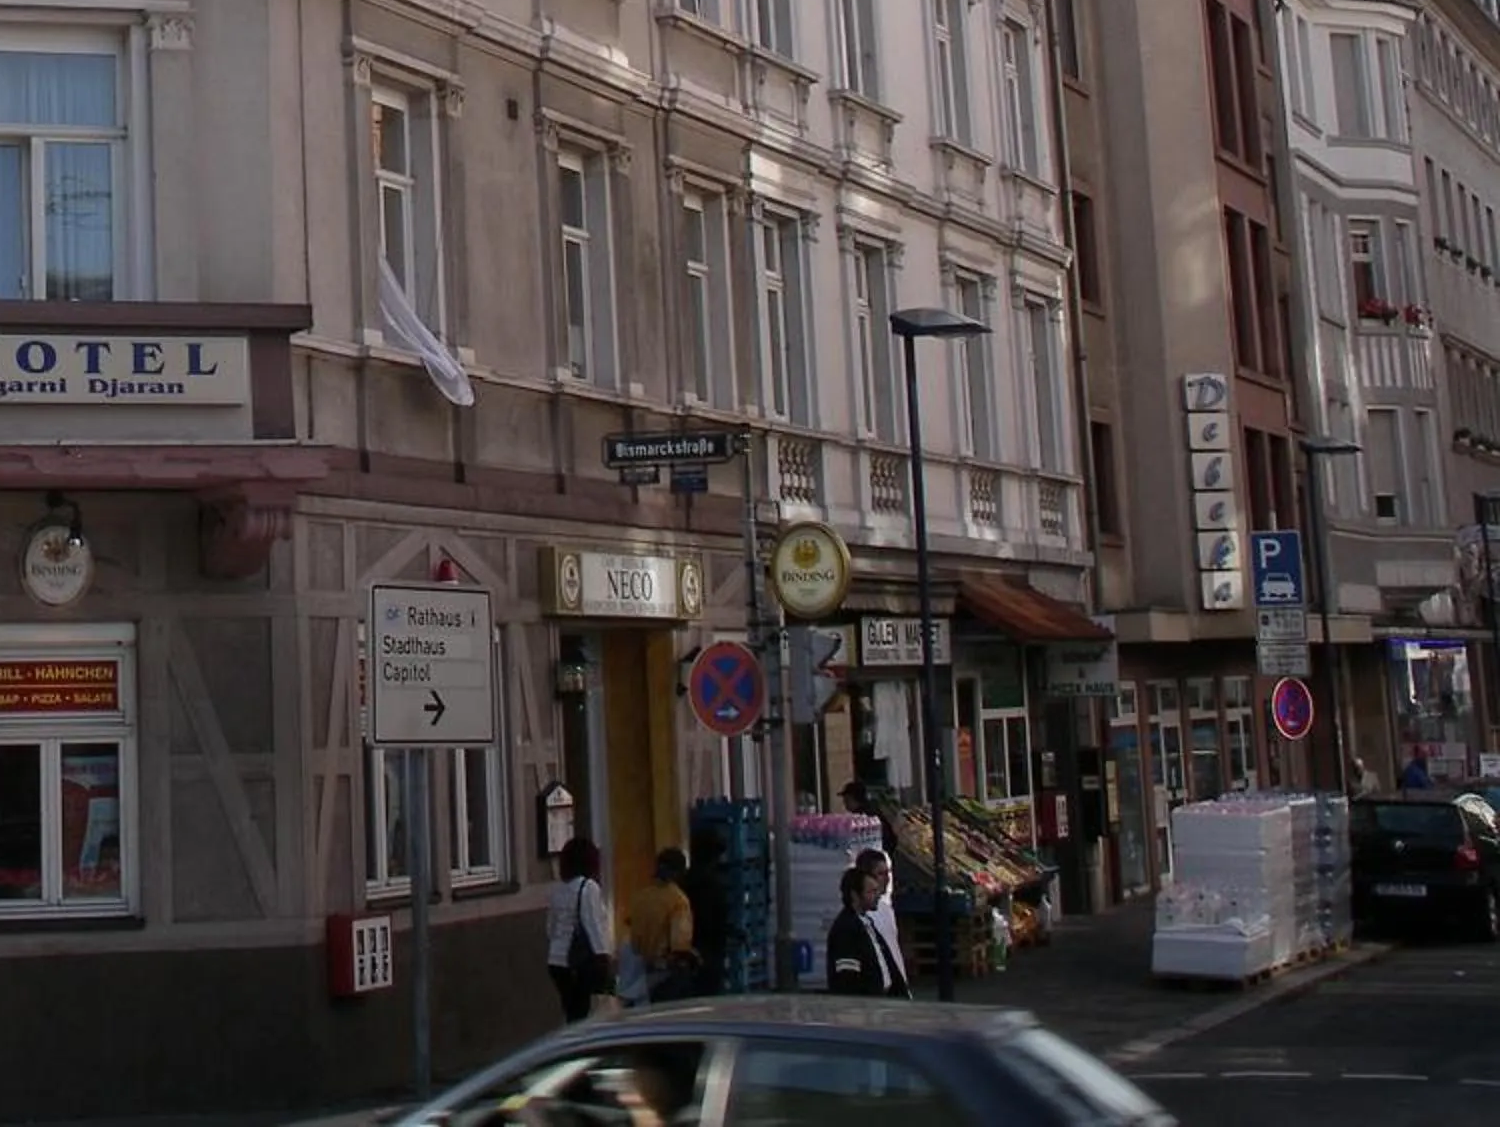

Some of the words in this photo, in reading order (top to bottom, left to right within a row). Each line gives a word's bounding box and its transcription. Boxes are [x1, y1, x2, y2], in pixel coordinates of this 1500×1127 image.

[88, 378, 184, 398] Djaran
[1259, 538, 1281, 569] P
[606, 570, 653, 601] NECO
[407, 606, 461, 628] Rathaus
[383, 635, 446, 656] Stadthaus
[34, 665, 113, 680] HÄHNCHEN
[383, 662, 431, 684] Capitol
